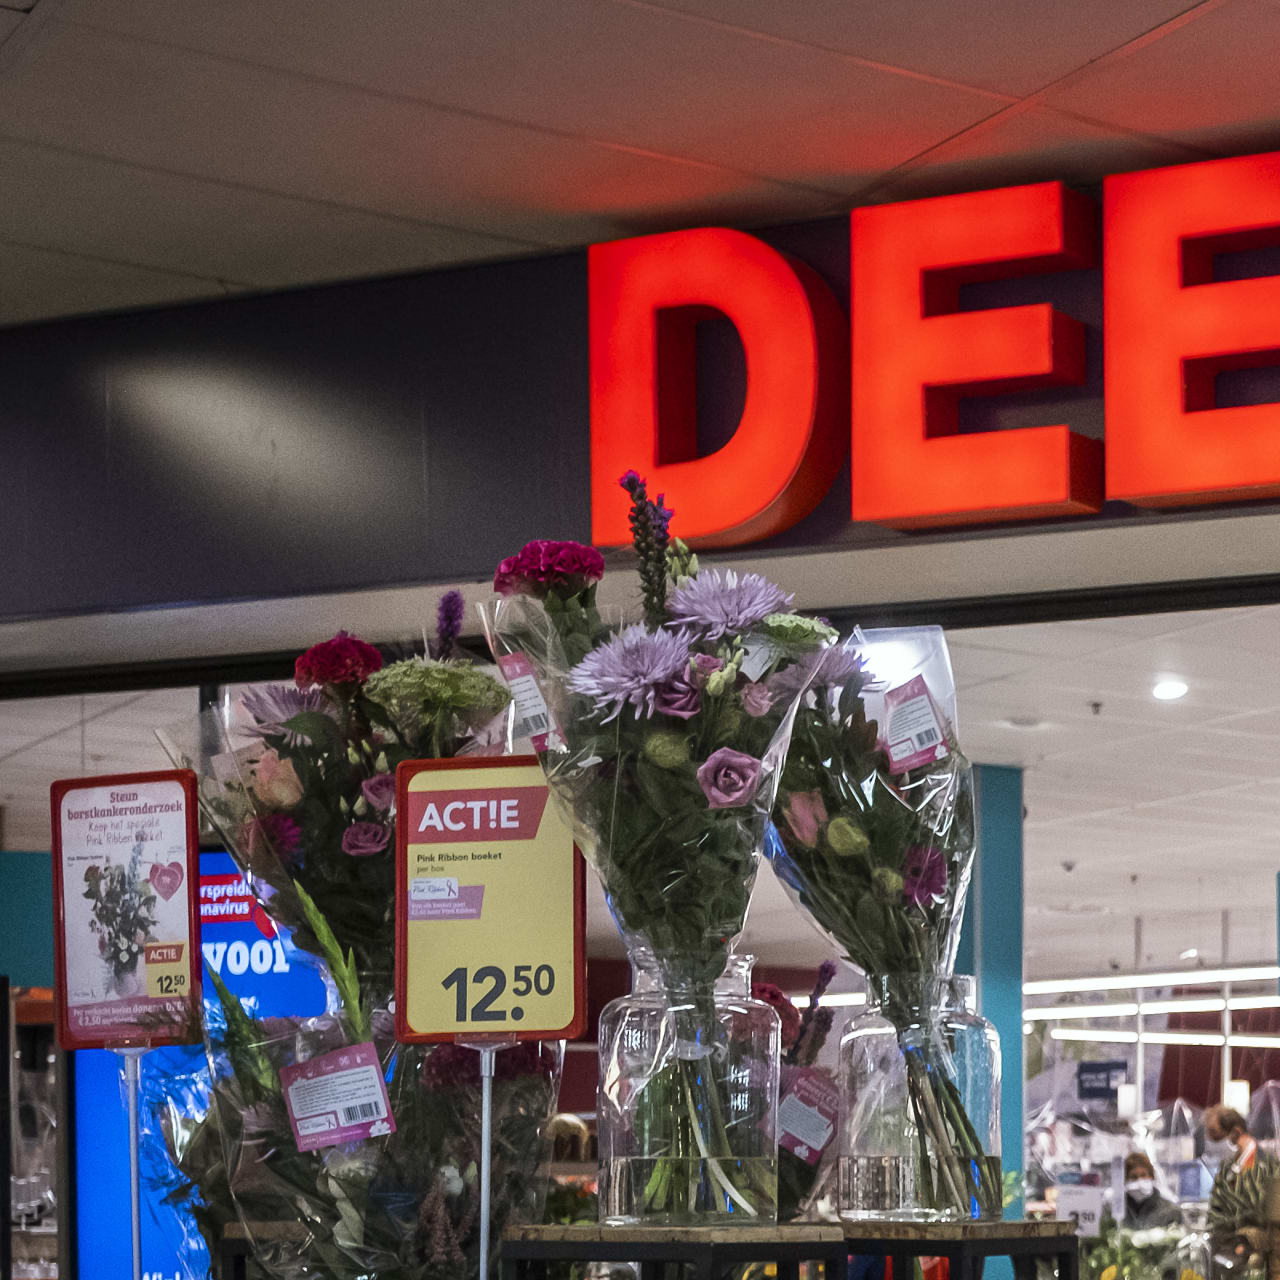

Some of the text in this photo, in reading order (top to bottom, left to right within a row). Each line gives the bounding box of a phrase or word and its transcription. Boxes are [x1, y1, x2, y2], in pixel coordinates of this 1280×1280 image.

[110, 791, 138, 803] Steun
[67, 800, 183, 820] borstkankeronderzoek
[88, 821, 107, 834] Koop
[86, 834, 103, 847] Pink
[417, 851, 502, 862] Pink Ribbon boeket
[417, 866, 428, 874] per
